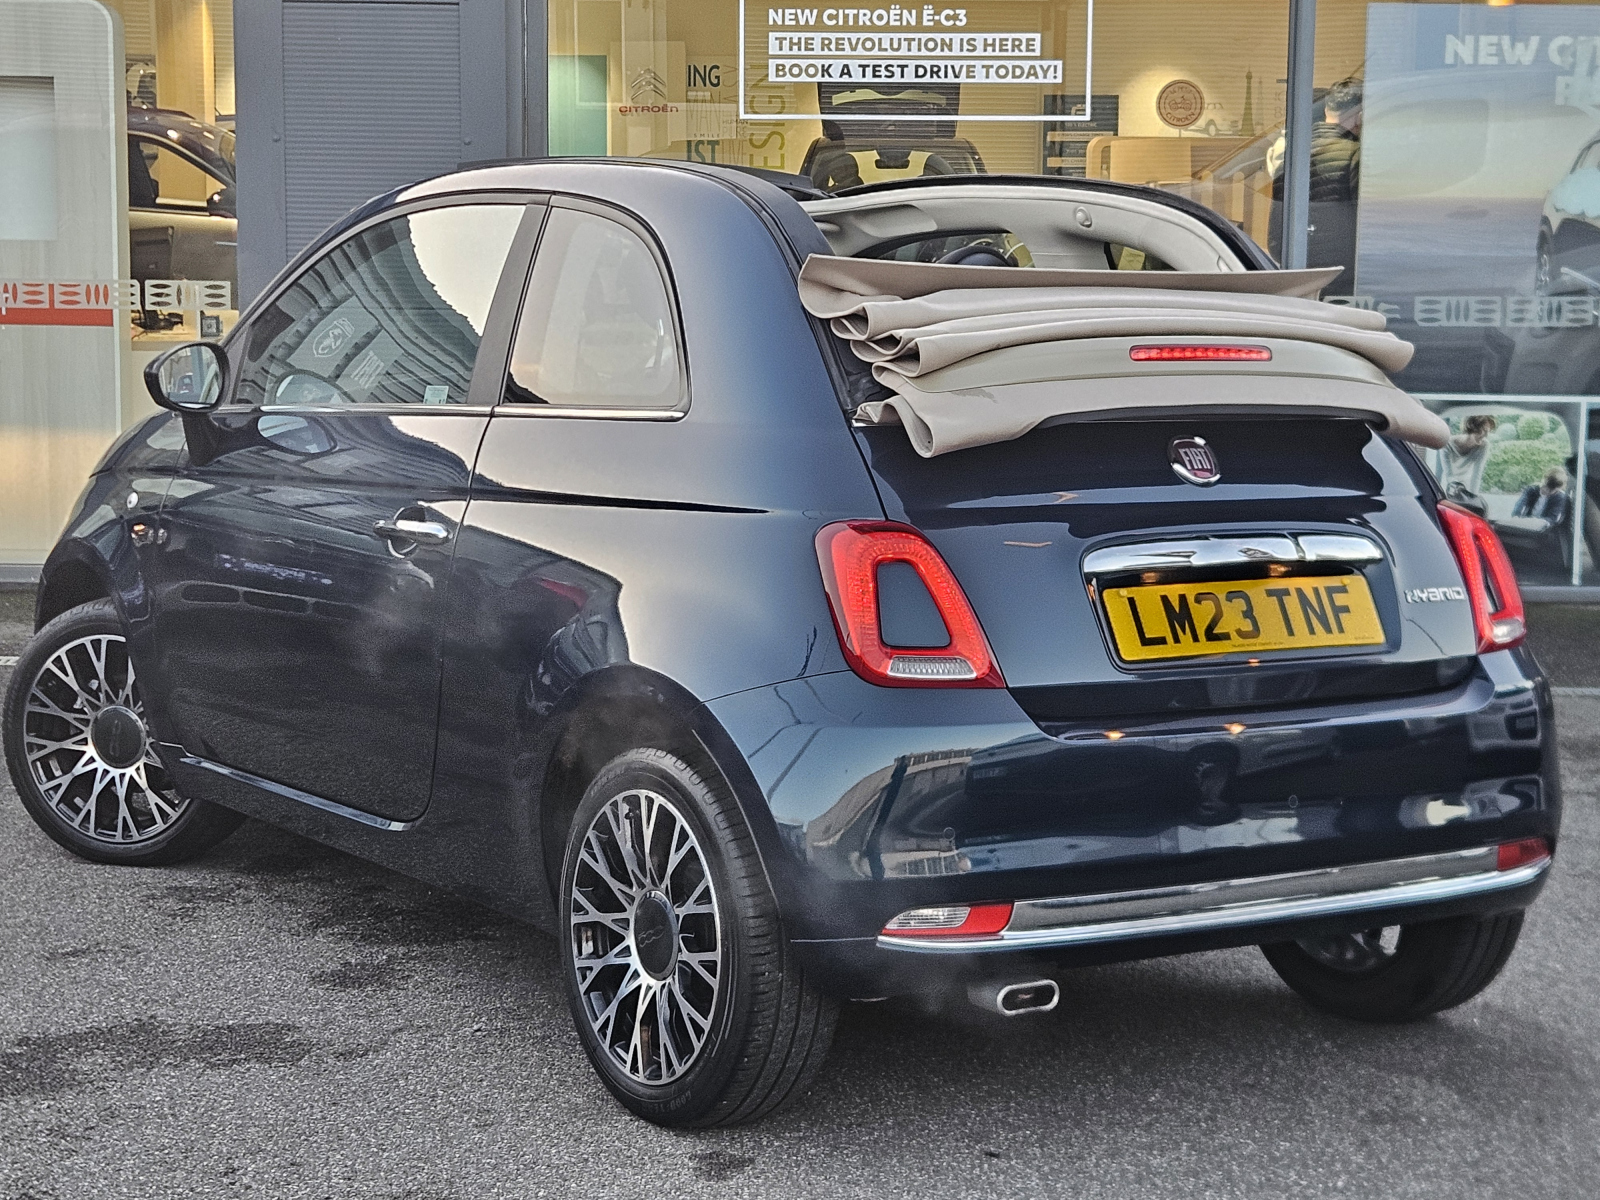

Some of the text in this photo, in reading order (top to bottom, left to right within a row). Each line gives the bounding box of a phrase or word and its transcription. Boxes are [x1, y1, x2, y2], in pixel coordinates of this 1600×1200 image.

[768, 4, 967, 27] NEW CITROËN Ë-C3
[774, 37, 1036, 53] THE REVOLUTION IS HERE
[1444, 34, 1540, 65] NEW
[687, 64, 721, 88] ING
[775, 63, 1058, 80] BOOK A TEST DRIVE TODAY!
[1178, 447, 1211, 470] FIAT
[1126, 585, 1351, 647] LM23 TNF
